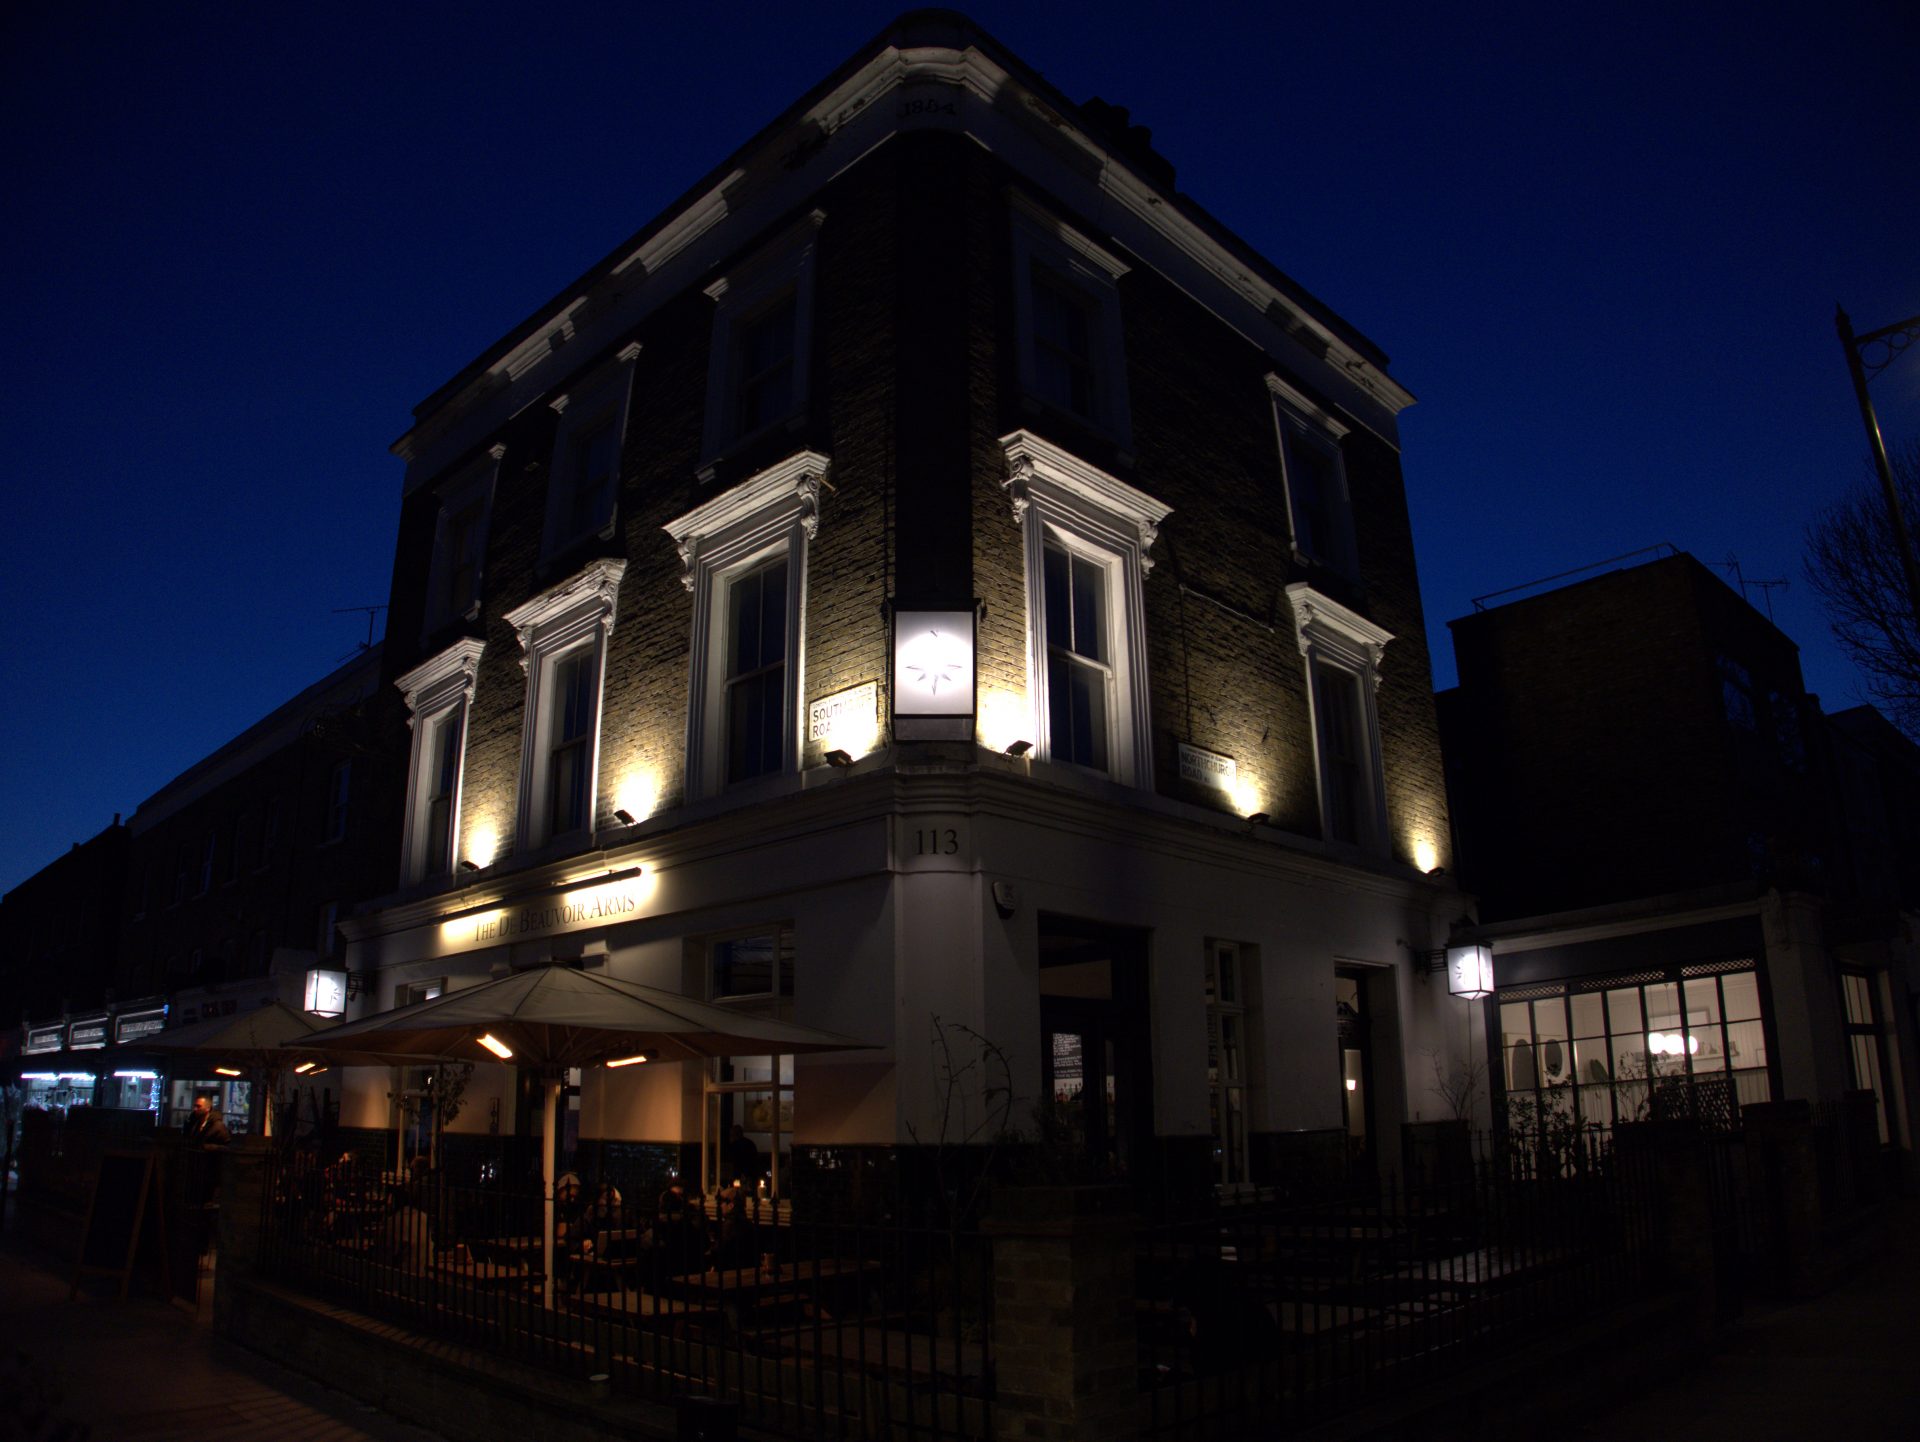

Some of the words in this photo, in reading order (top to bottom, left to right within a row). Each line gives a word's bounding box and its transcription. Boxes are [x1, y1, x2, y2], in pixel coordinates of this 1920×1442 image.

[915, 828, 959, 855] 113
[475, 919, 496, 942] THE
[498, 915, 515, 938] DE
[519, 902, 586, 933] BEAUVOIR
[589, 893, 636, 919] ARMS
